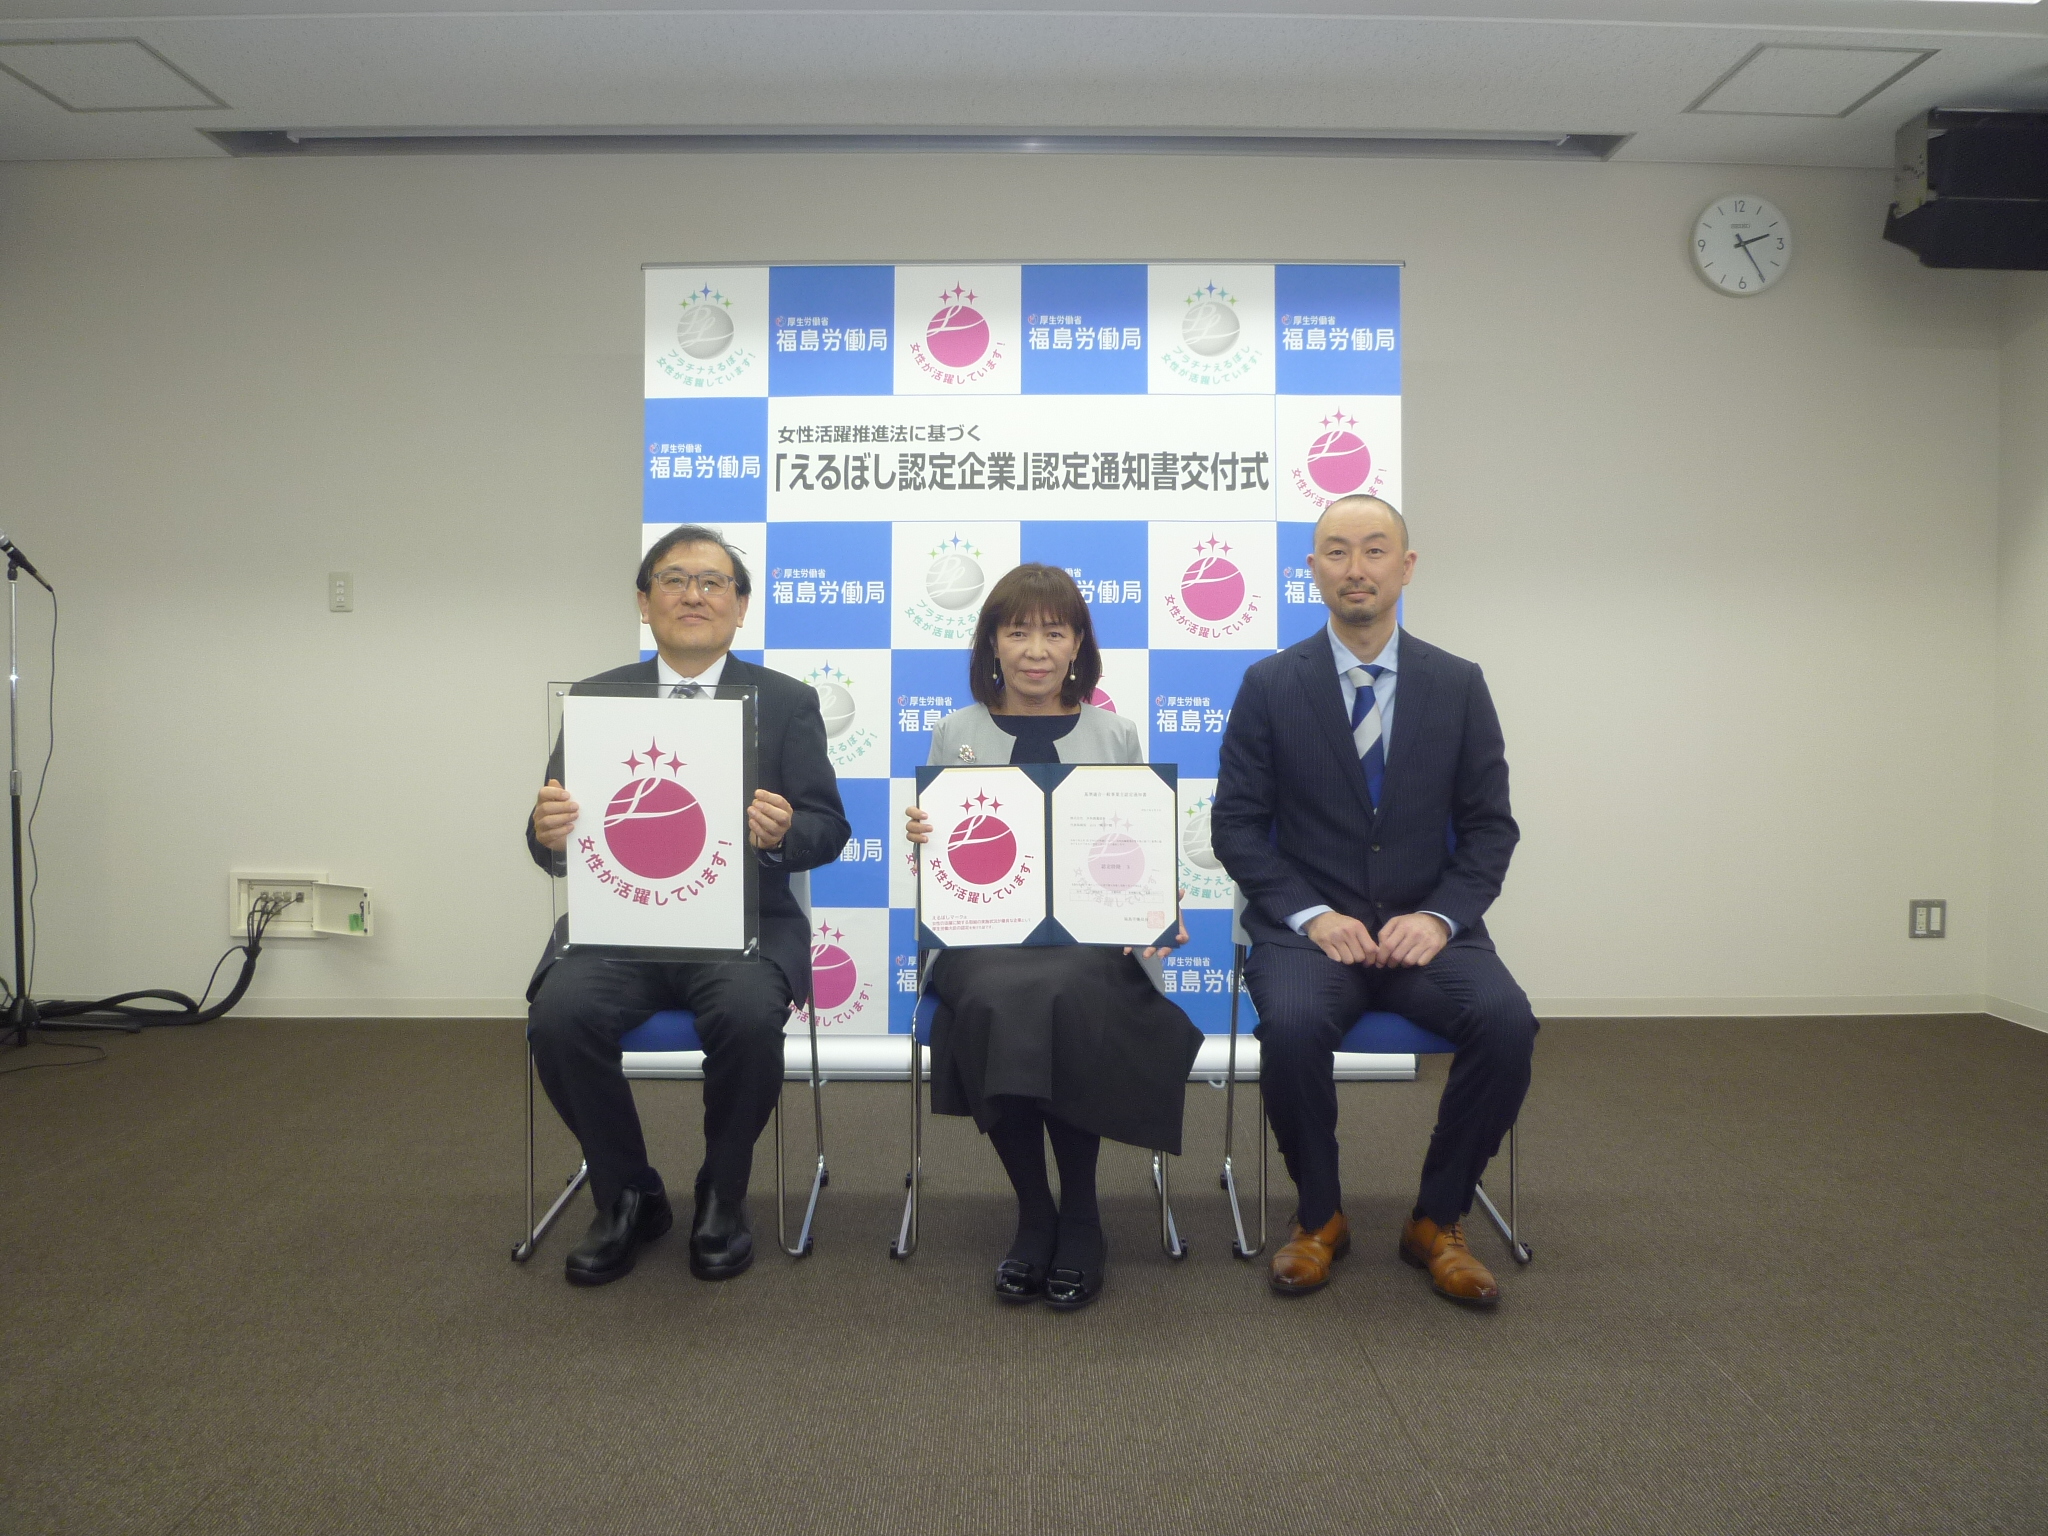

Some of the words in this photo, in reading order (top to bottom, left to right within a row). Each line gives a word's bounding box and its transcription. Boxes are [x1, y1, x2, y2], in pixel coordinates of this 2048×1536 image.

[1734, 200, 1745, 213] 12
[1697, 239, 1706, 253] 9
[1776, 237, 1785, 251] 3
[1738, 276, 1747, 290] 6
[787, 316, 829, 327] 厚生労働省
[1039, 315, 1082, 325] 厚生労働省
[1293, 315, 1336, 326] 厚生労働省
[776, 328, 888, 353] 福島労働局
[1028, 326, 1142, 351] 福島労働局
[1282, 327, 1395, 352] 福島労働局
[778, 424, 981, 444] 女性活躍推進法に基づく
[660, 443, 703, 454] 厚生労働省
[649, 455, 761, 480] 福島労働局
[775, 451, 1269, 492] 「えるぼし認定企業」認定通知書交付式
[783, 568, 826, 579] 厚生労働省
[772, 580, 885, 605] 福島労働局
[1077, 580, 1142, 604] 労働局
[916, 599, 983, 624] プラチナえる
[904, 606, 974, 639] 女性が活躍して
[909, 696, 953, 707] 厚生労働省
[1167, 696, 1211, 707] 厚生労働省
[1156, 709, 1230, 733] 福島労
[578, 835, 733, 906] 女性が活躍しています！
[929, 854, 1034, 904] 女性が活躍しています！
[1167, 956, 1210, 967] 厚生労働省
